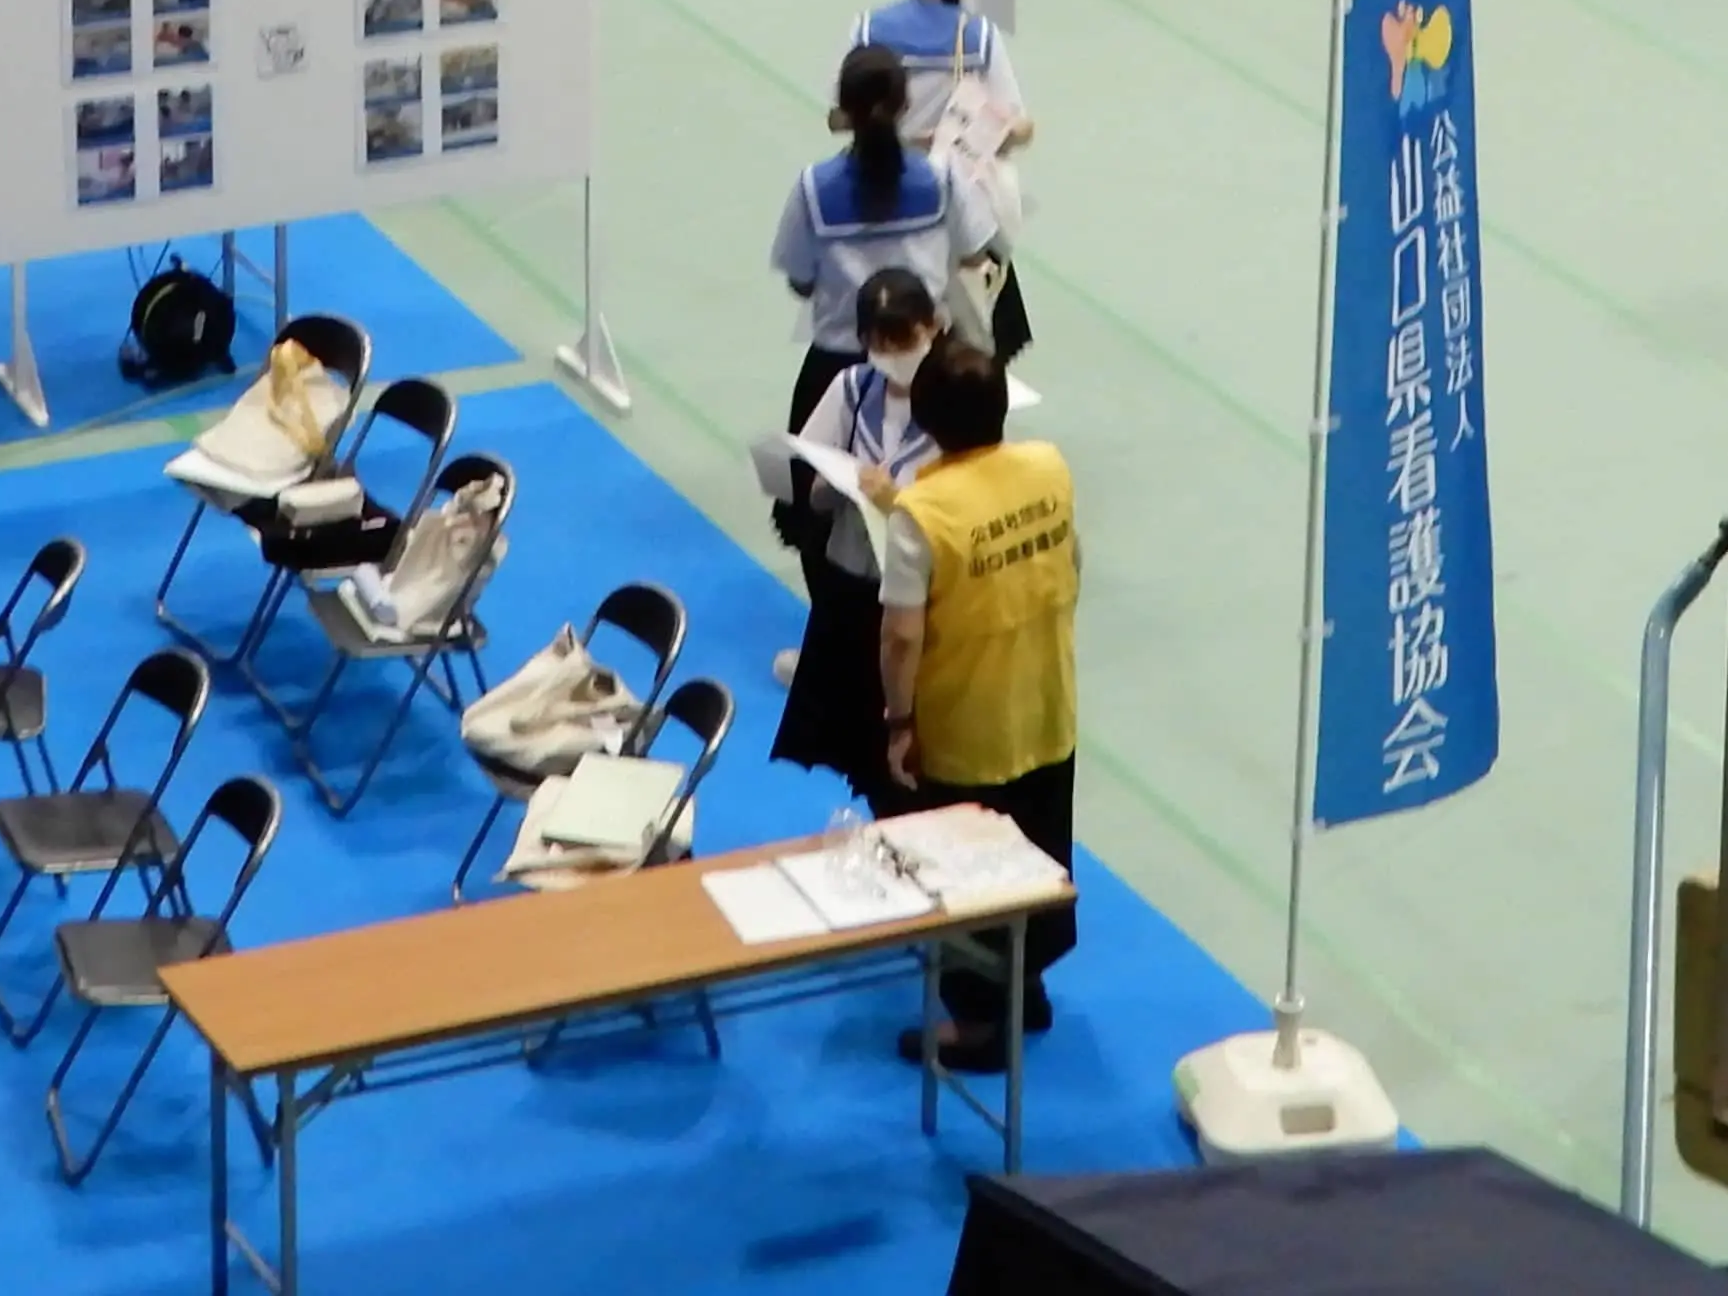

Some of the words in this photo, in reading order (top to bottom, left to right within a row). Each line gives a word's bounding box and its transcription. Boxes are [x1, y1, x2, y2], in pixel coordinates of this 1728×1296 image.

[1382, 132, 1449, 794] 山口県看護協会
[1429, 110, 1476, 453] 公益社団法人
